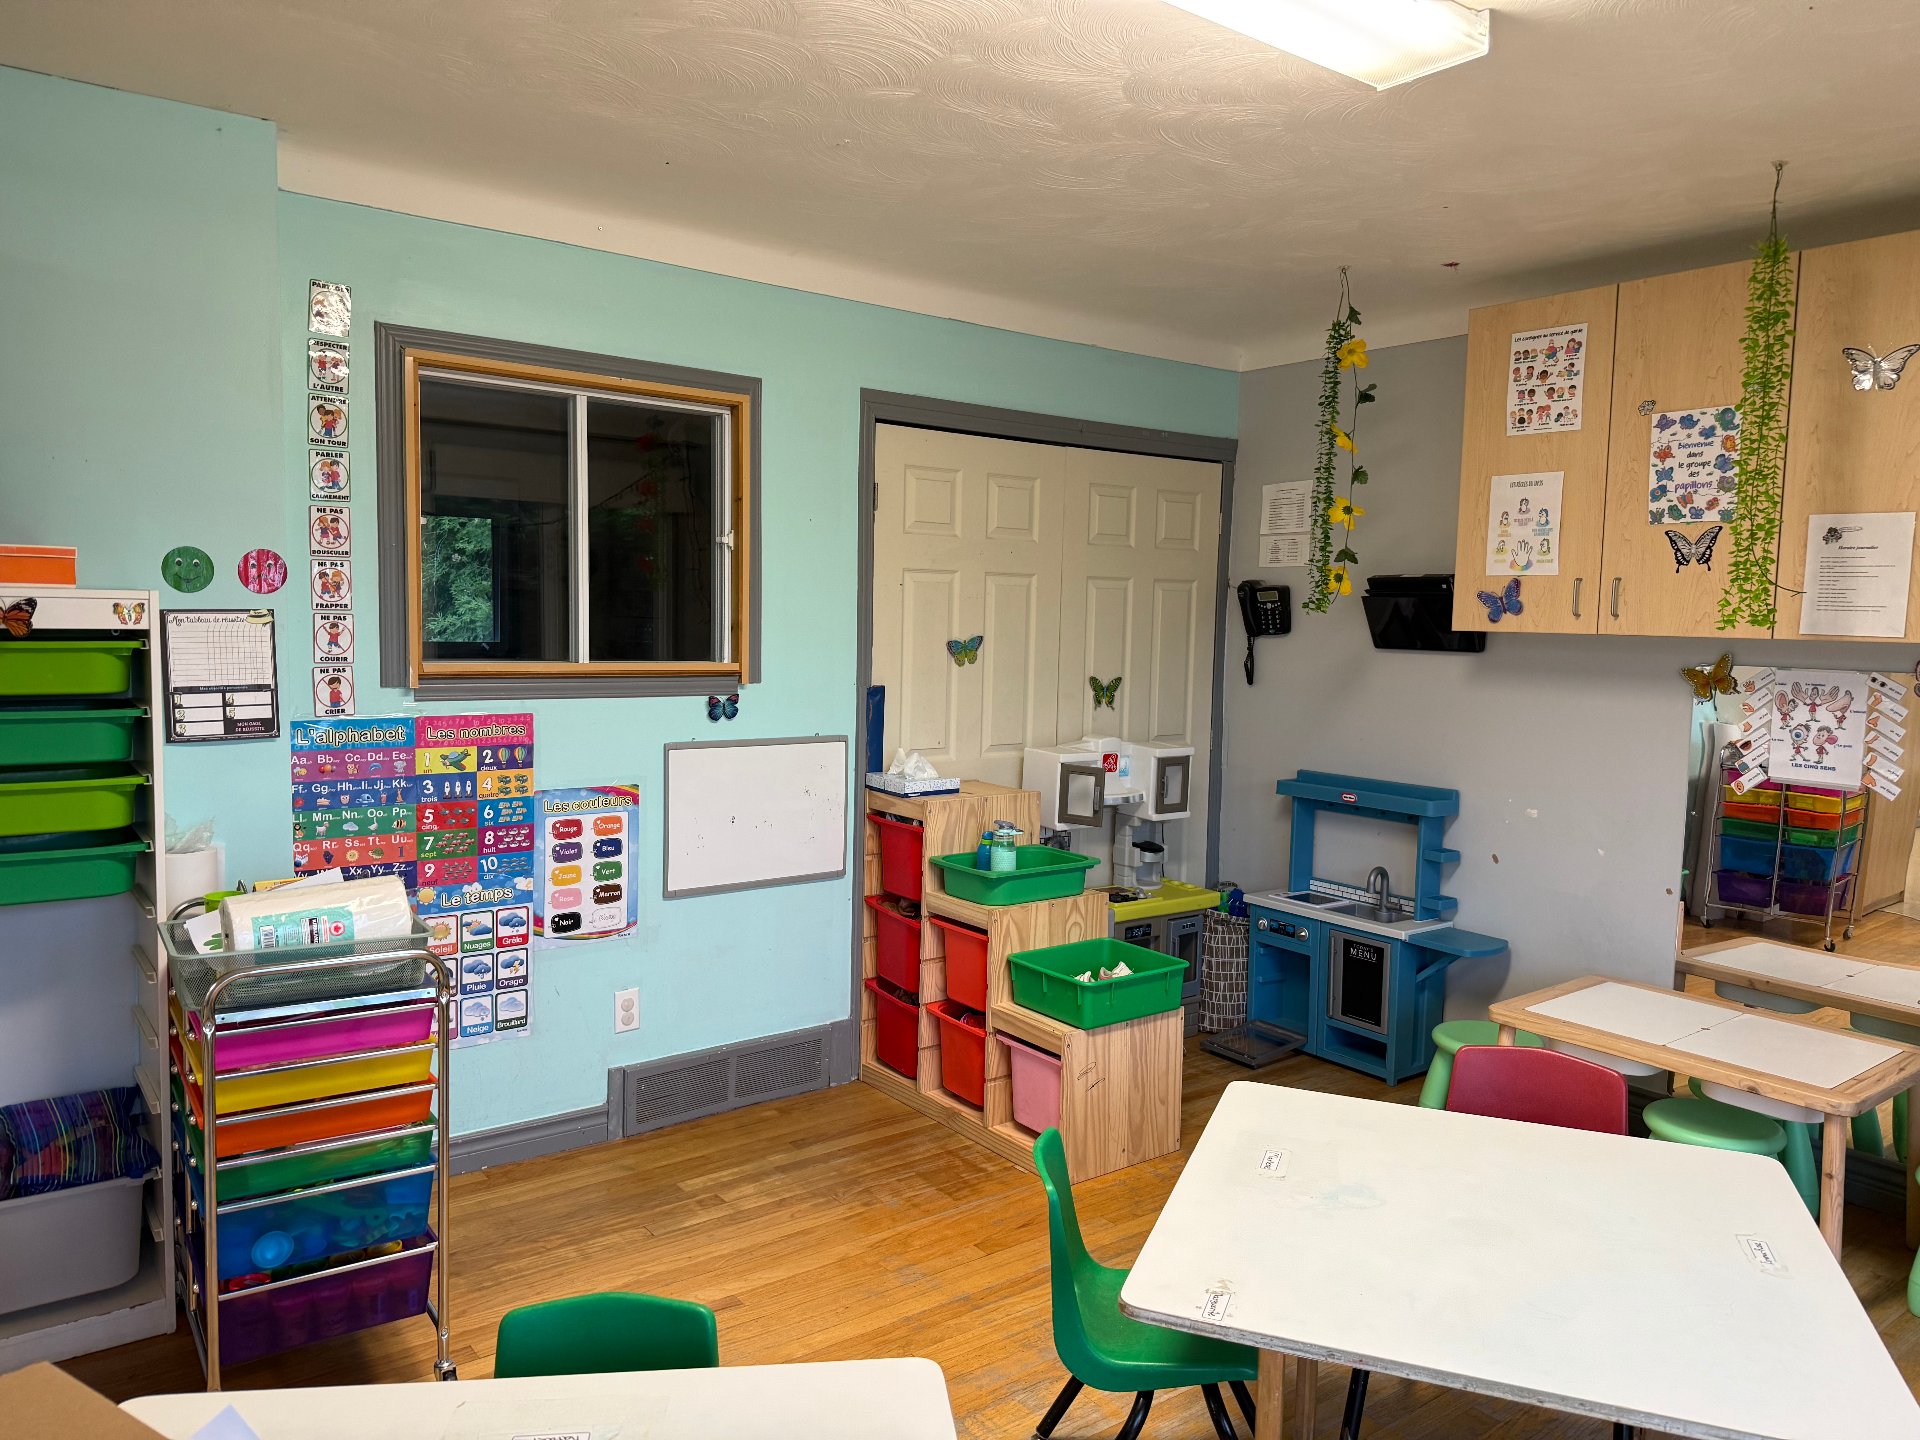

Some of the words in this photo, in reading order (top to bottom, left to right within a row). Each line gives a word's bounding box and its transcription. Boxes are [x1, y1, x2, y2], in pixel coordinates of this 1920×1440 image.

[313, 383, 344, 392] L'AUTRE
[328, 439, 347, 447] TOUR
[1678, 441, 1714, 449] Bienvenue
[316, 451, 344, 459] PARLER
[1686, 461, 1711, 470] groupe
[1675, 481, 1713, 493] papillons
[296, 726, 406, 747] L'alphabet
[427, 727, 455, 740] Les
[460, 724, 526, 739] nombres
[424, 752, 430, 767] 1
[482, 750, 494, 764] 2
[423, 780, 434, 794] 3
[482, 777, 493, 791] 4
[544, 798, 569, 812] Les
[572, 796, 632, 811] couleurs
[423, 808, 435, 823] 5
[484, 804, 494, 819] 6
[559, 825, 578, 833] Rouge
[599, 822, 620, 830] Orange
[424, 836, 434, 850] 7
[484, 831, 495, 845] 8
[420, 850, 437, 858] sept
[560, 847, 578, 855] Violet
[424, 863, 436, 878] 9
[480, 856, 498, 873] 10
[441, 892, 461, 907] Le
[465, 888, 514, 904] temps
[599, 890, 621, 898] Marron
[429, 945, 453, 954] Soleil
[464, 941, 492, 951] Nuages
[1350, 947, 1376, 961] MENU
[466, 983, 487, 991] Pluie
[500, 978, 524, 987] Orage
[466, 1024, 489, 1034] Neige
